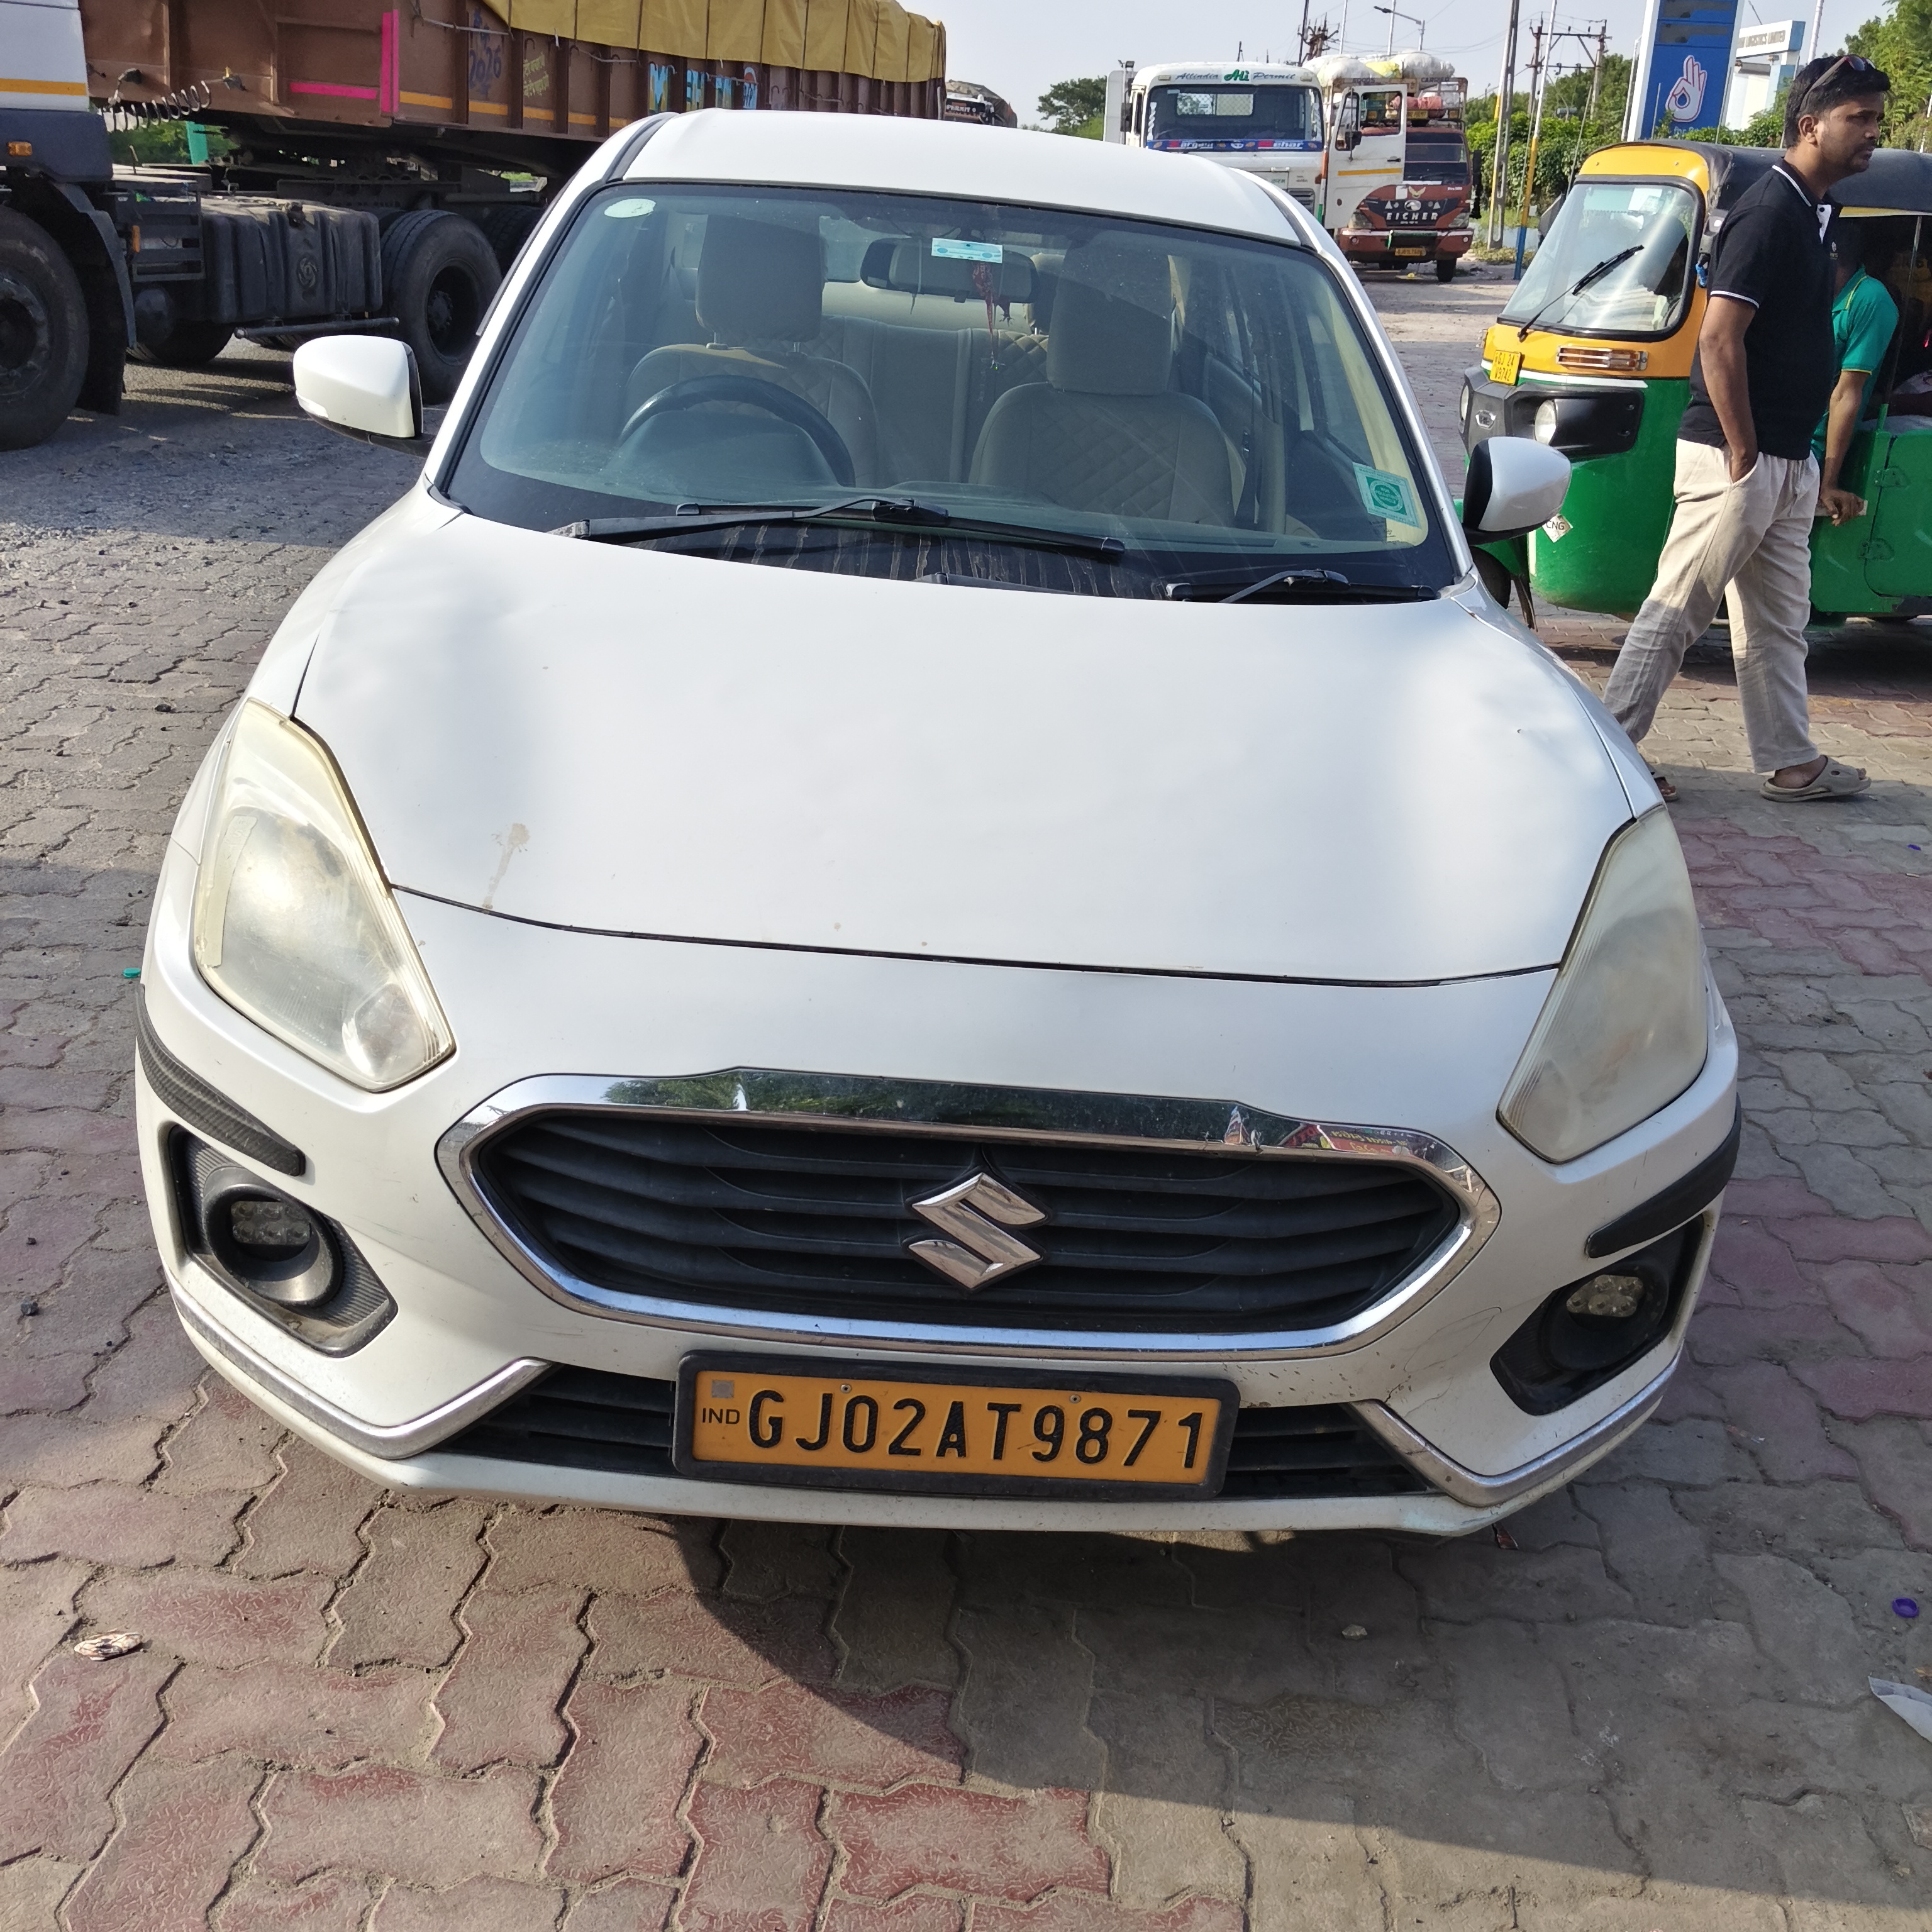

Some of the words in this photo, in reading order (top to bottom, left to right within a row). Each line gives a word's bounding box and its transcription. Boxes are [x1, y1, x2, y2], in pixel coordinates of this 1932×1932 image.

[1386, 212, 1438, 220] EICHER
[1546, 520, 1565, 530] CNG
[702, 1407, 740, 1424] IND
[748, 1389, 1203, 1468] GJ02AT9871
